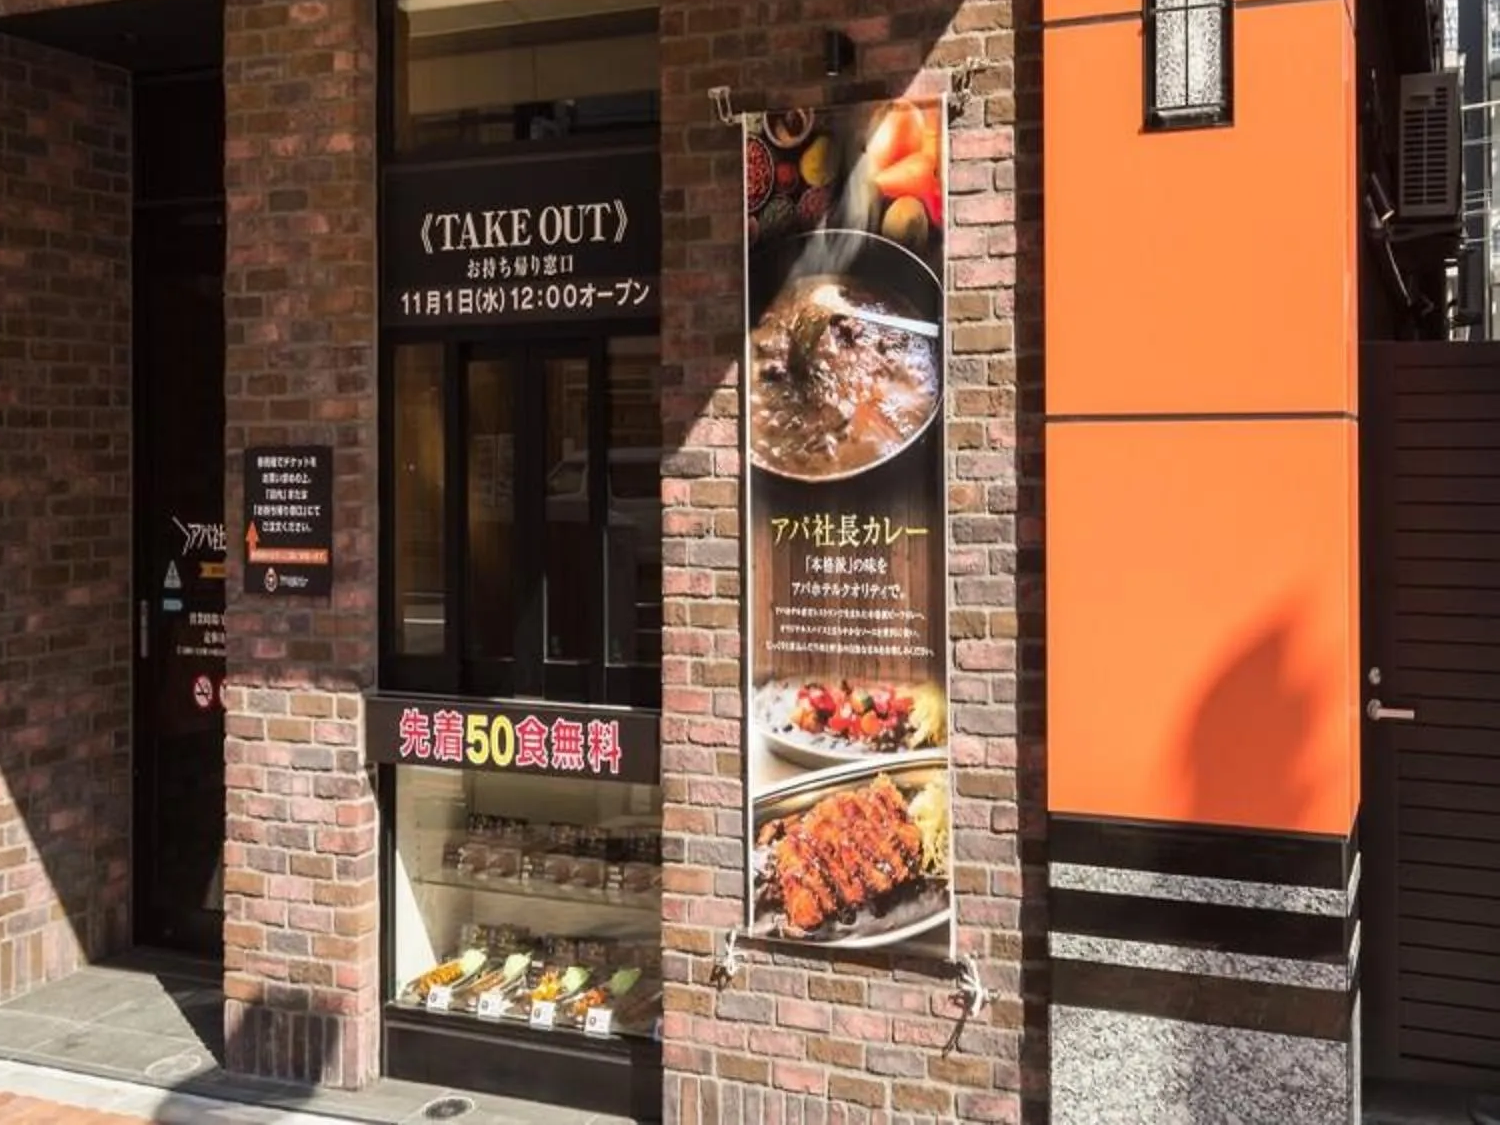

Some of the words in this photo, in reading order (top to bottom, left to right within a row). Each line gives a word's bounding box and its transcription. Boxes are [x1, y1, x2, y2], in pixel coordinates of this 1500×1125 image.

[467, 254, 574, 279] お持ち帰り窓口
[771, 512, 929, 548] アパ社長カレー
[400, 707, 621, 773] 先着50食無料
